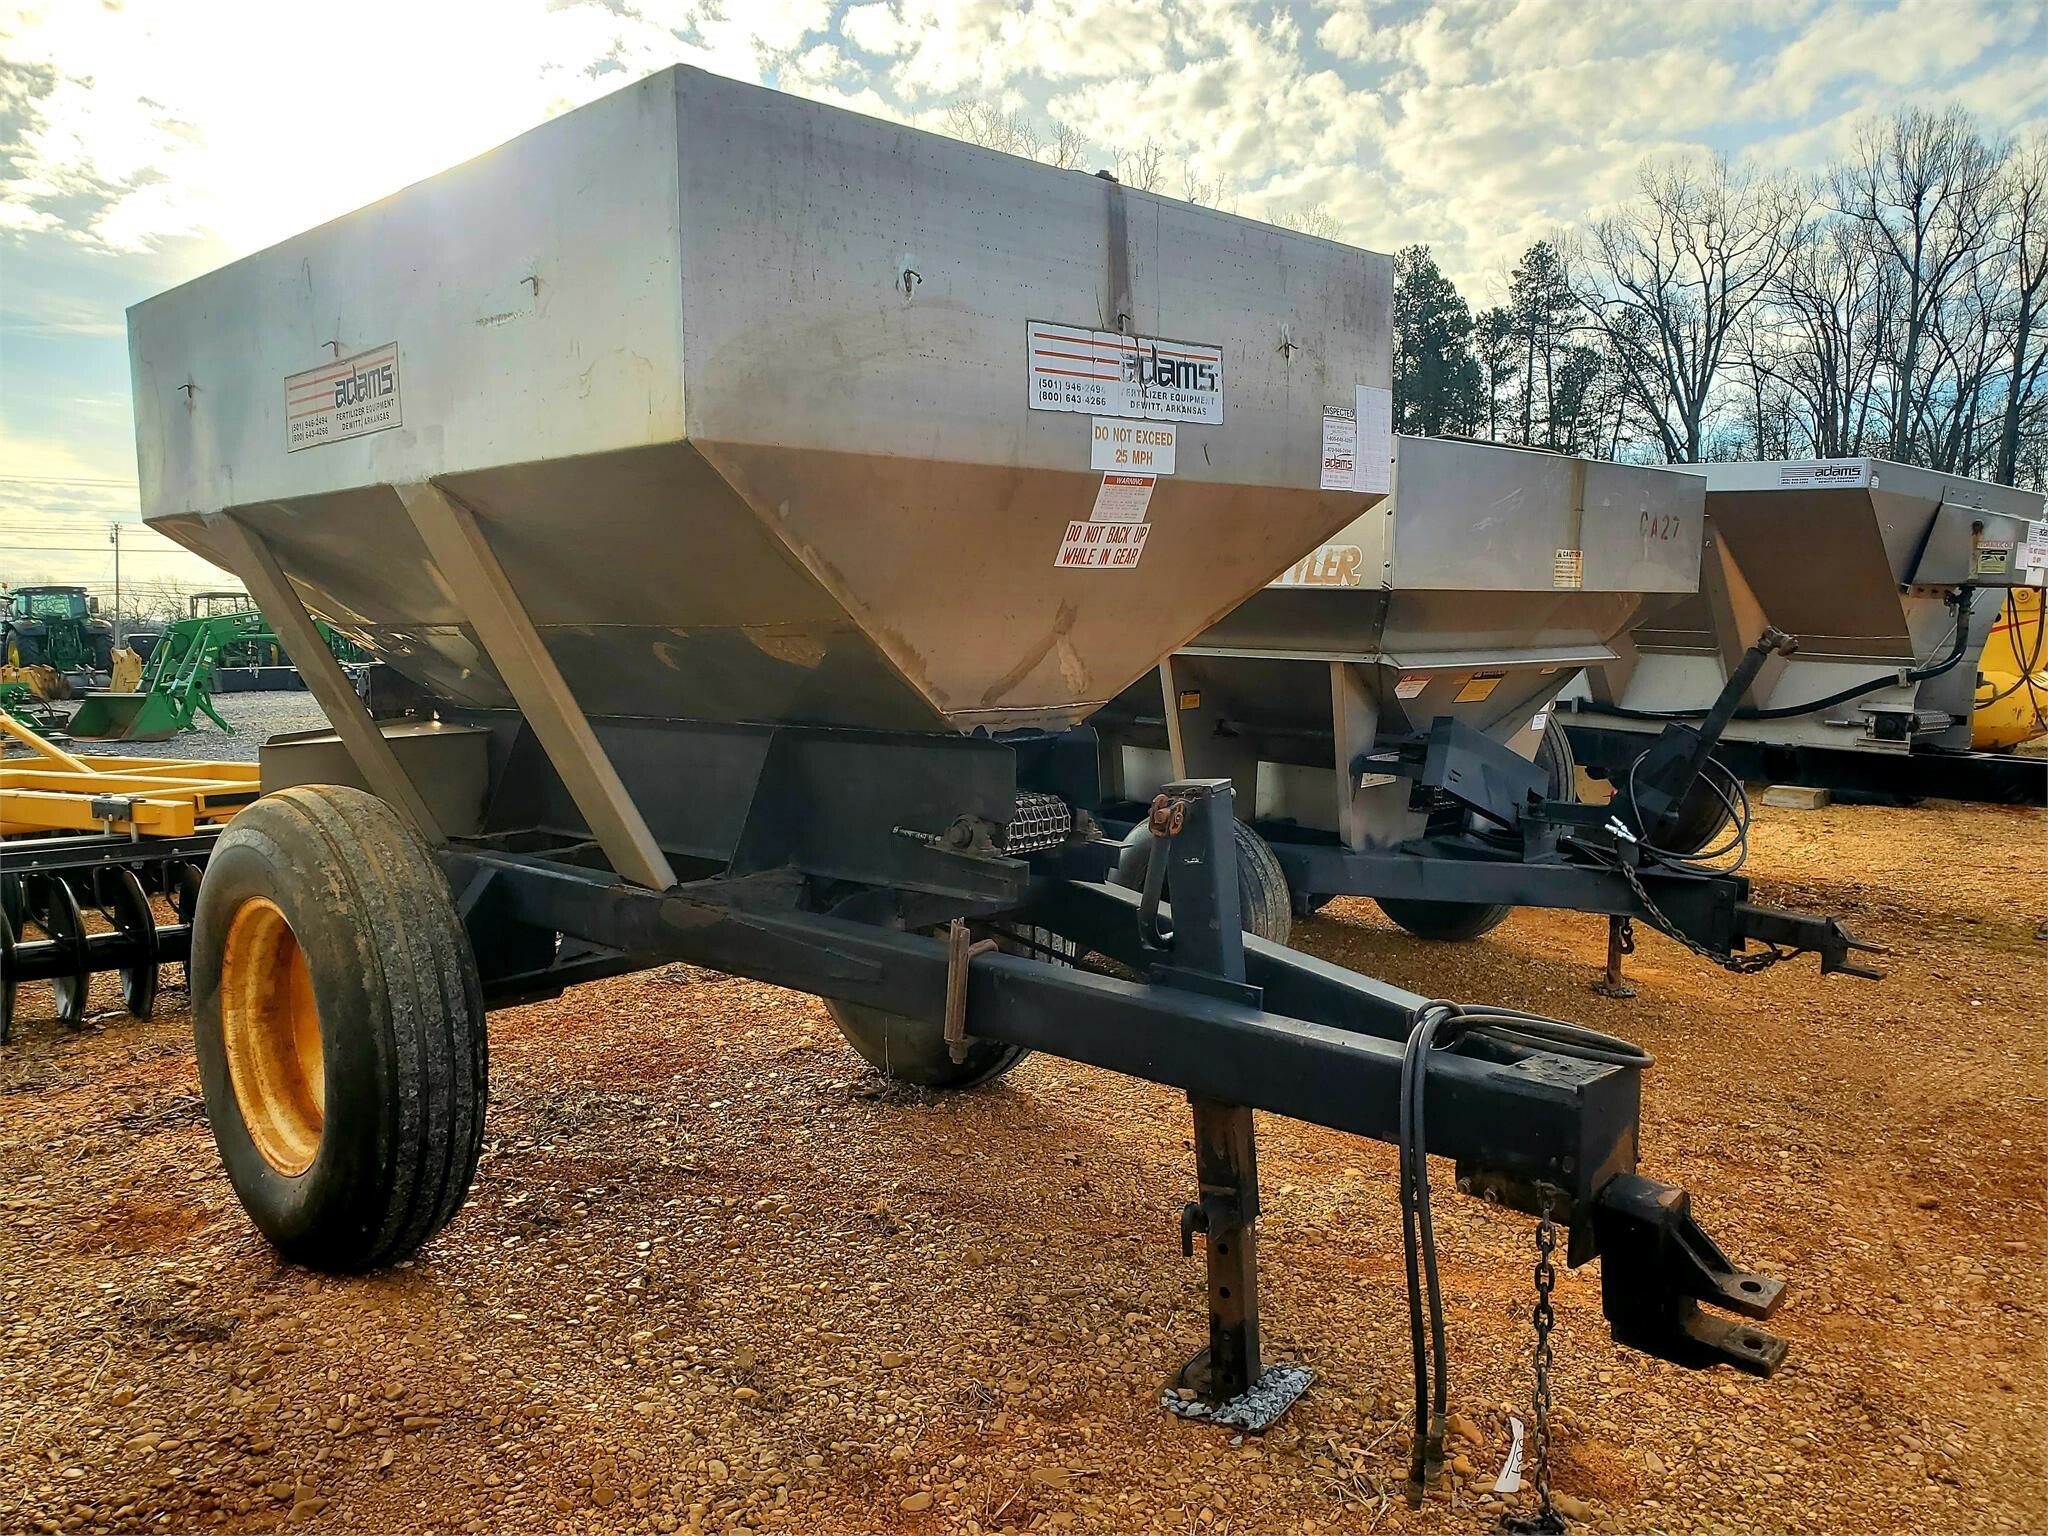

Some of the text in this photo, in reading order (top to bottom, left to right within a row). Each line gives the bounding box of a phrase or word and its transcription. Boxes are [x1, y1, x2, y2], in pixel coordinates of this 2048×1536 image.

[335, 364, 392, 408] adams
[1039, 378, 1062, 391] (501)
[1039, 391, 1062, 403] (800)
[336, 398, 395, 422] FERTILIZER EQUIPMENT
[1166, 404, 1207, 415] ARKANSAS
[1325, 406, 1355, 418] INSPECTED
[364, 411, 390, 426] ARKANSAS
[1095, 426, 1173, 446] DO NOT EXCEED
[1115, 449, 1153, 465] 25 MPH
[1324, 454, 1353, 470] adams
[1815, 465, 1861, 477] adams
[1116, 477, 1144, 486] WARNING
[1066, 525, 1147, 544] DO NOT BACK UP
[1062, 548, 1139, 565] WHILE IN GEAR
